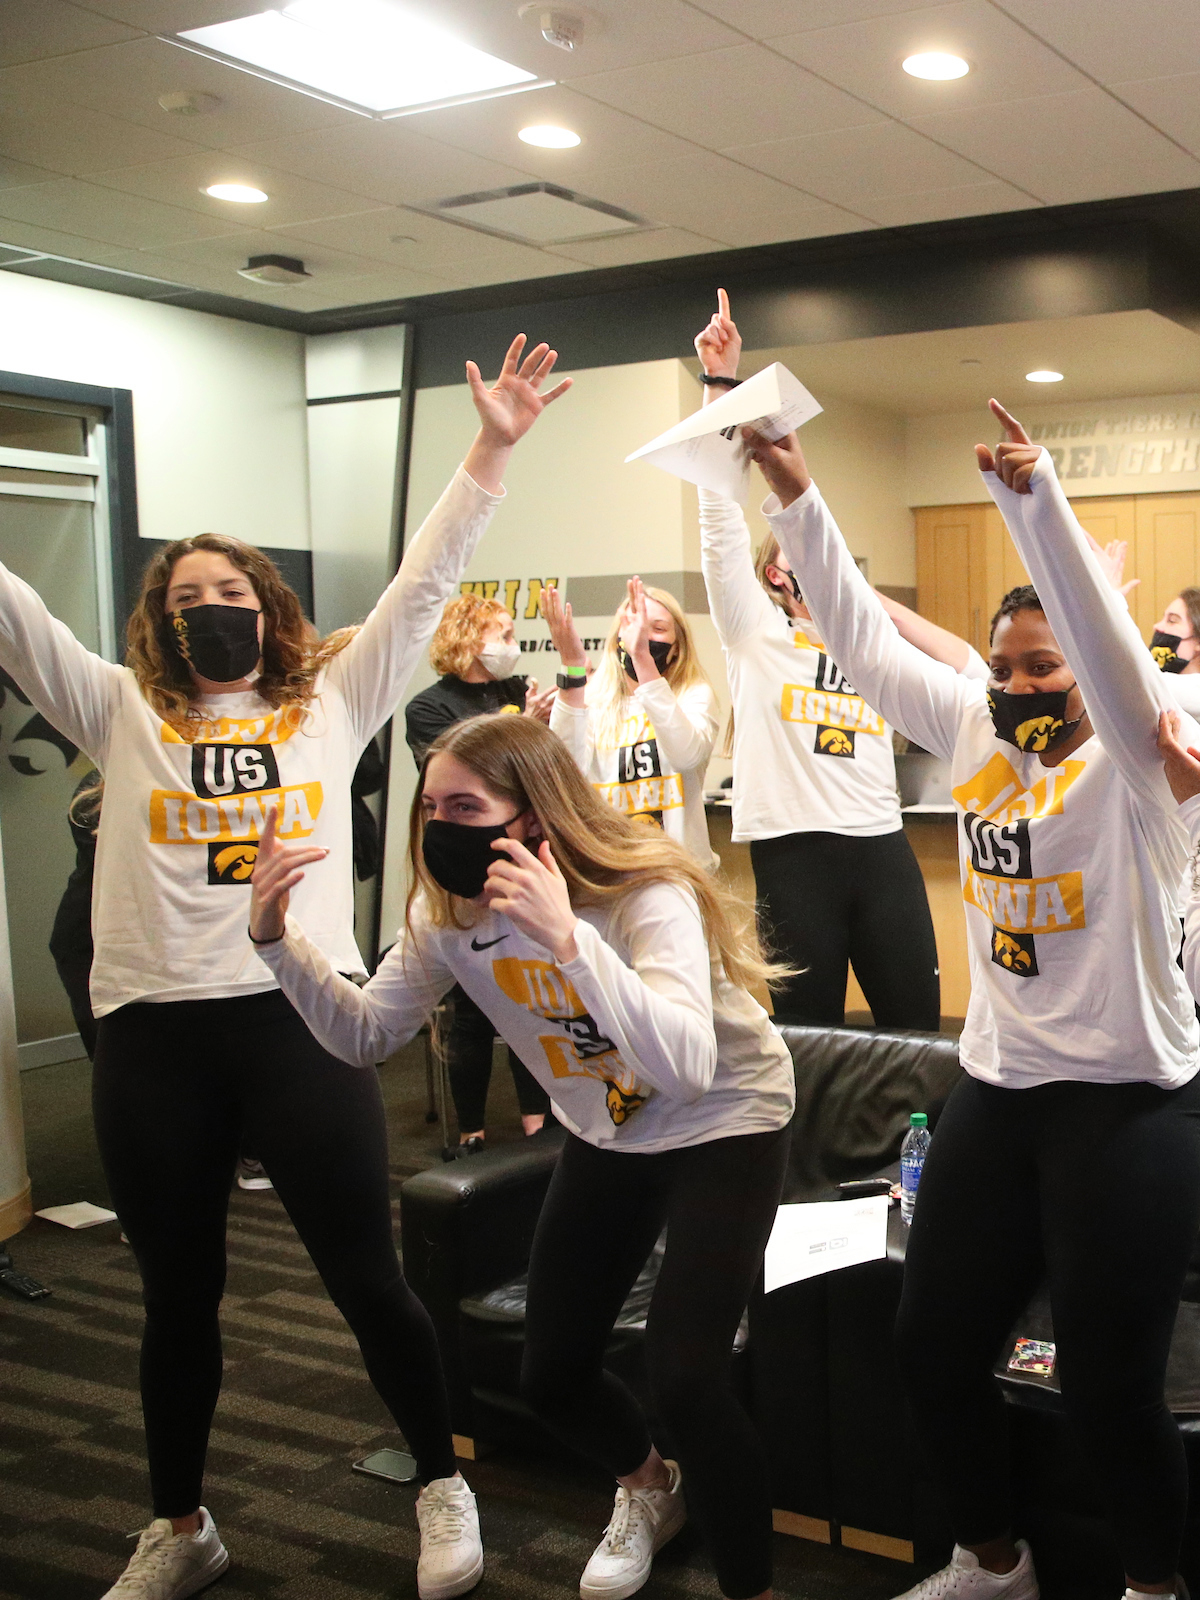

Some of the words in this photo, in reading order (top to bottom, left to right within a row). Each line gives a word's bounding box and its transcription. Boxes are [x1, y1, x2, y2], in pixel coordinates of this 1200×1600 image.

[1107, 413, 1180, 435] THERE
[790, 688, 880, 732] IOWA
[203, 747, 268, 796] US
[625, 743, 655, 780] US
[163, 788, 317, 840] IOWA
[970, 816, 1020, 875] US
